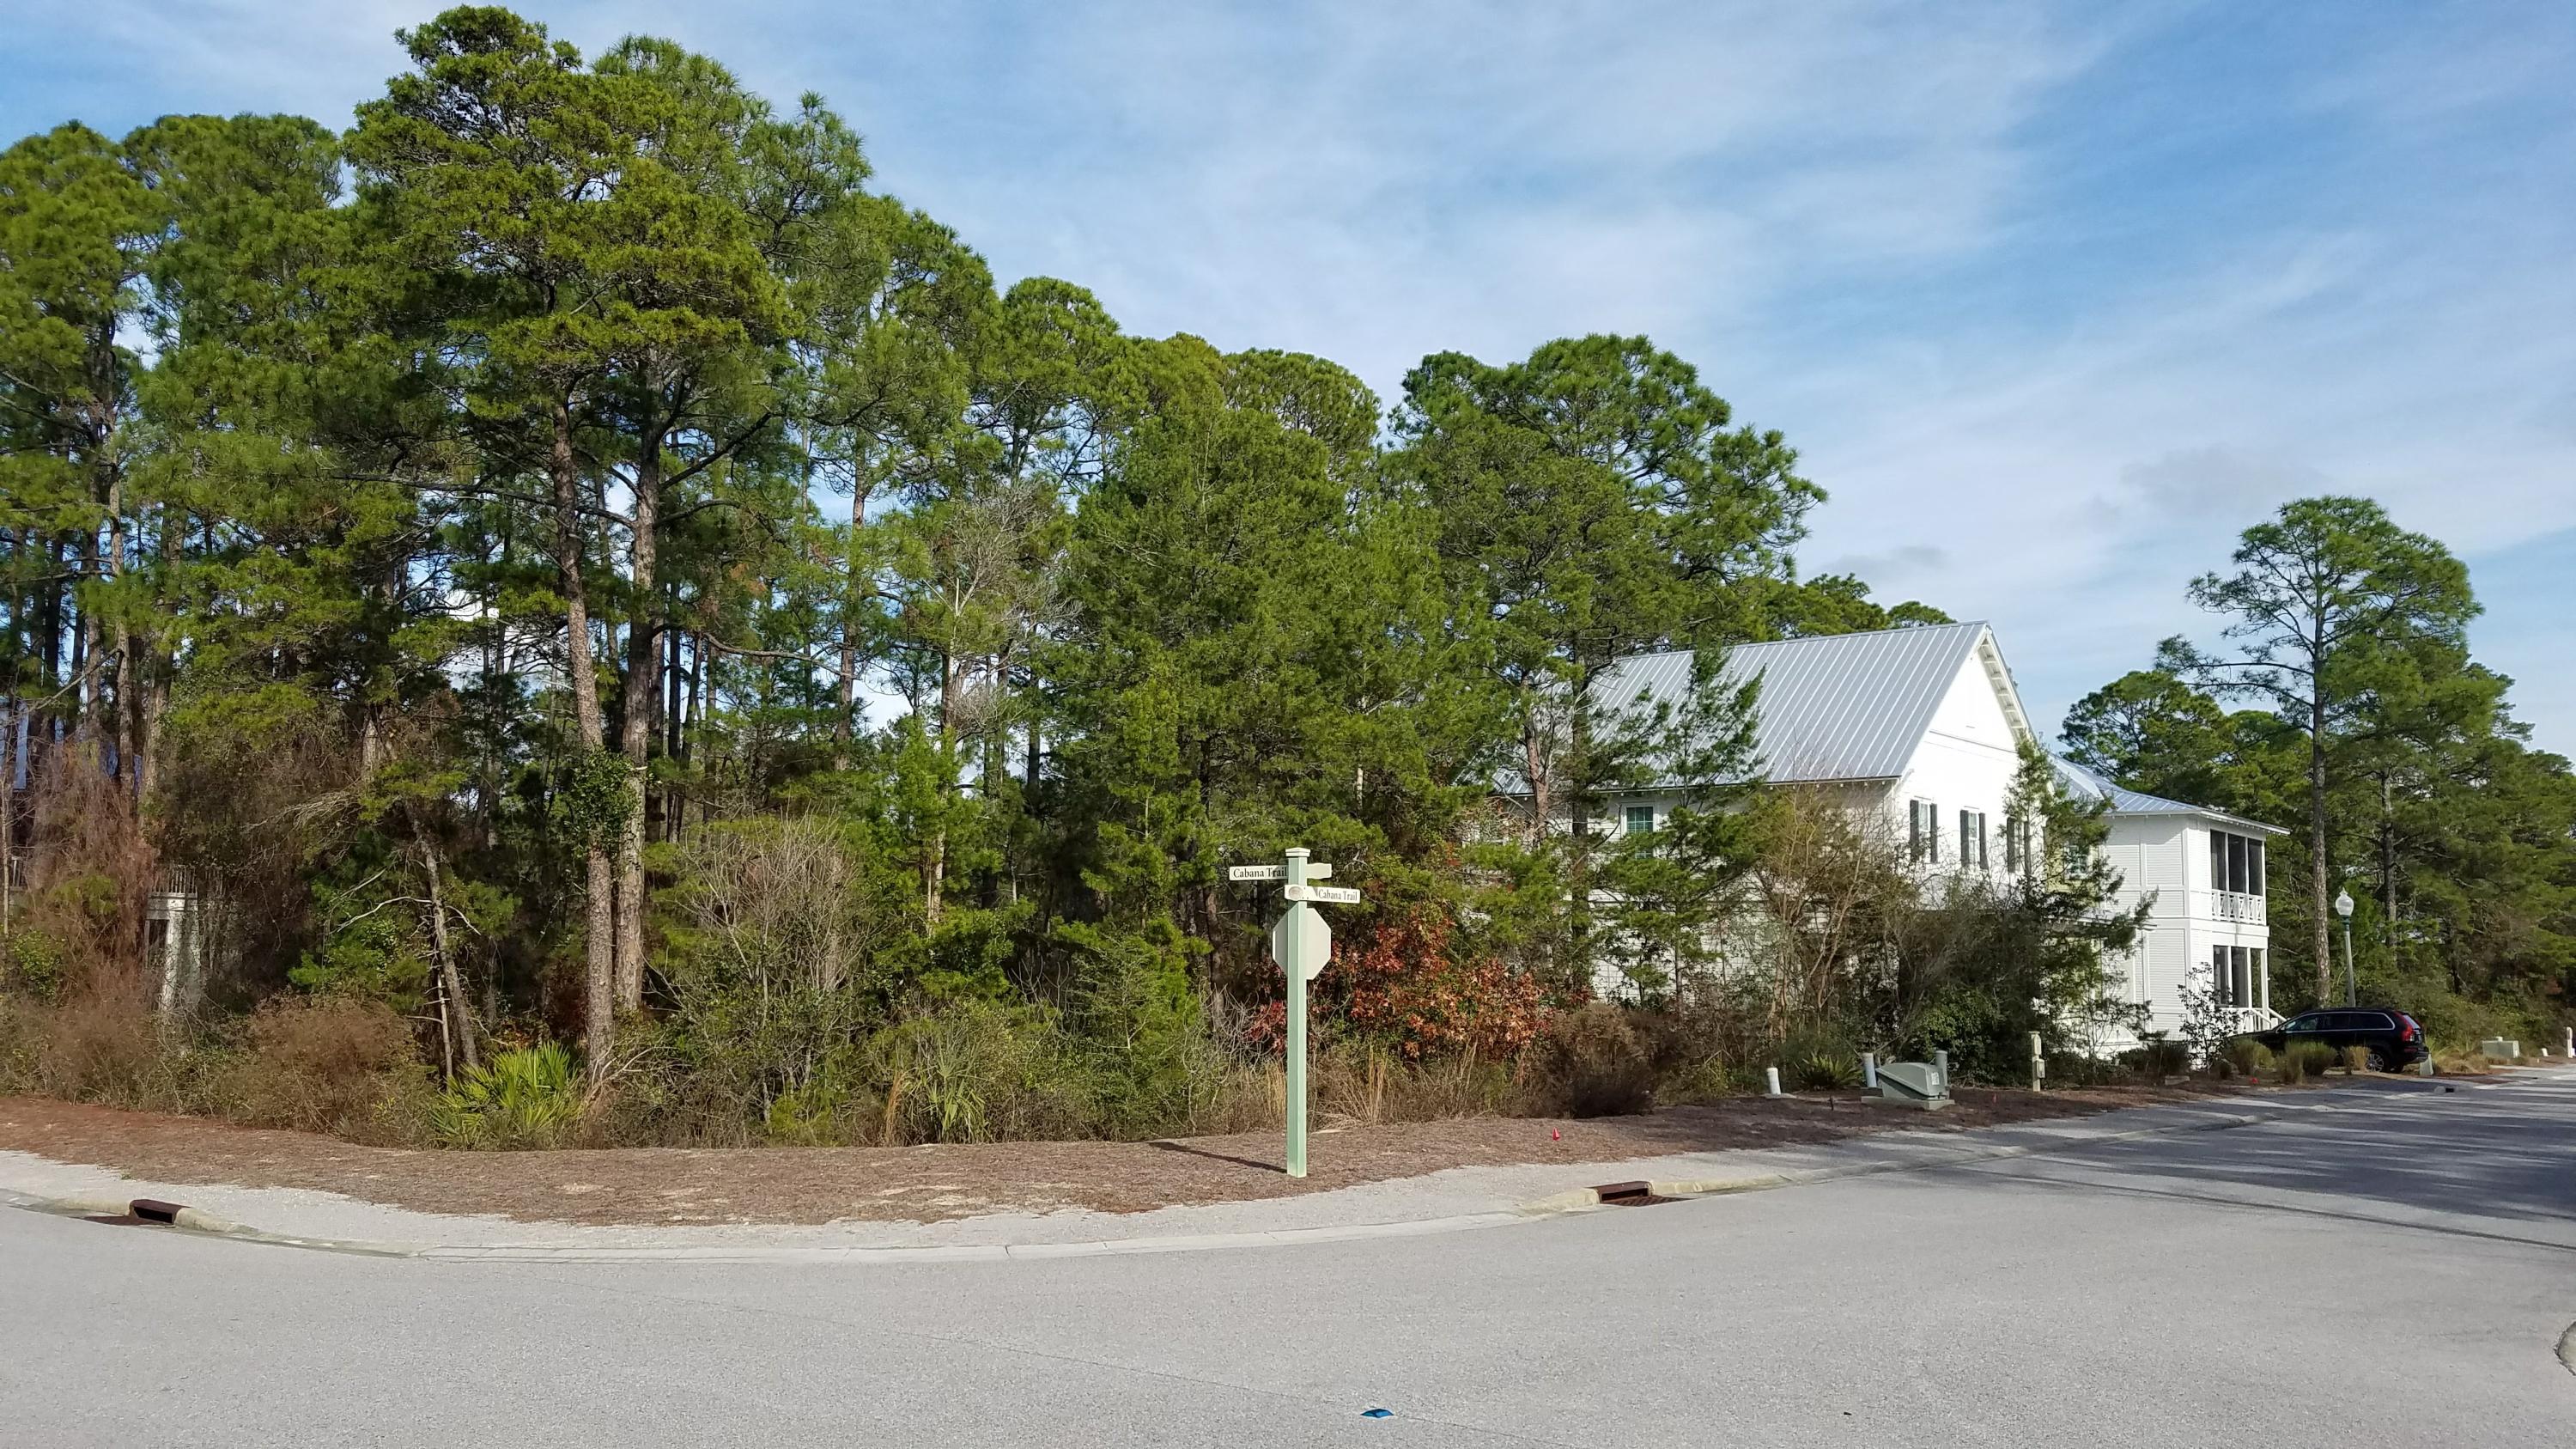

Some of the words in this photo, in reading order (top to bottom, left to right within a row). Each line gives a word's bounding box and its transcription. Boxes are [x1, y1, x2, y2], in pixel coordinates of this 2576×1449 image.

[1233, 868, 1264, 878] Cabana
[1267, 867, 1288, 877] Trail
[1318, 889, 1341, 900] Cabana
[1343, 891, 1358, 901] Trail
